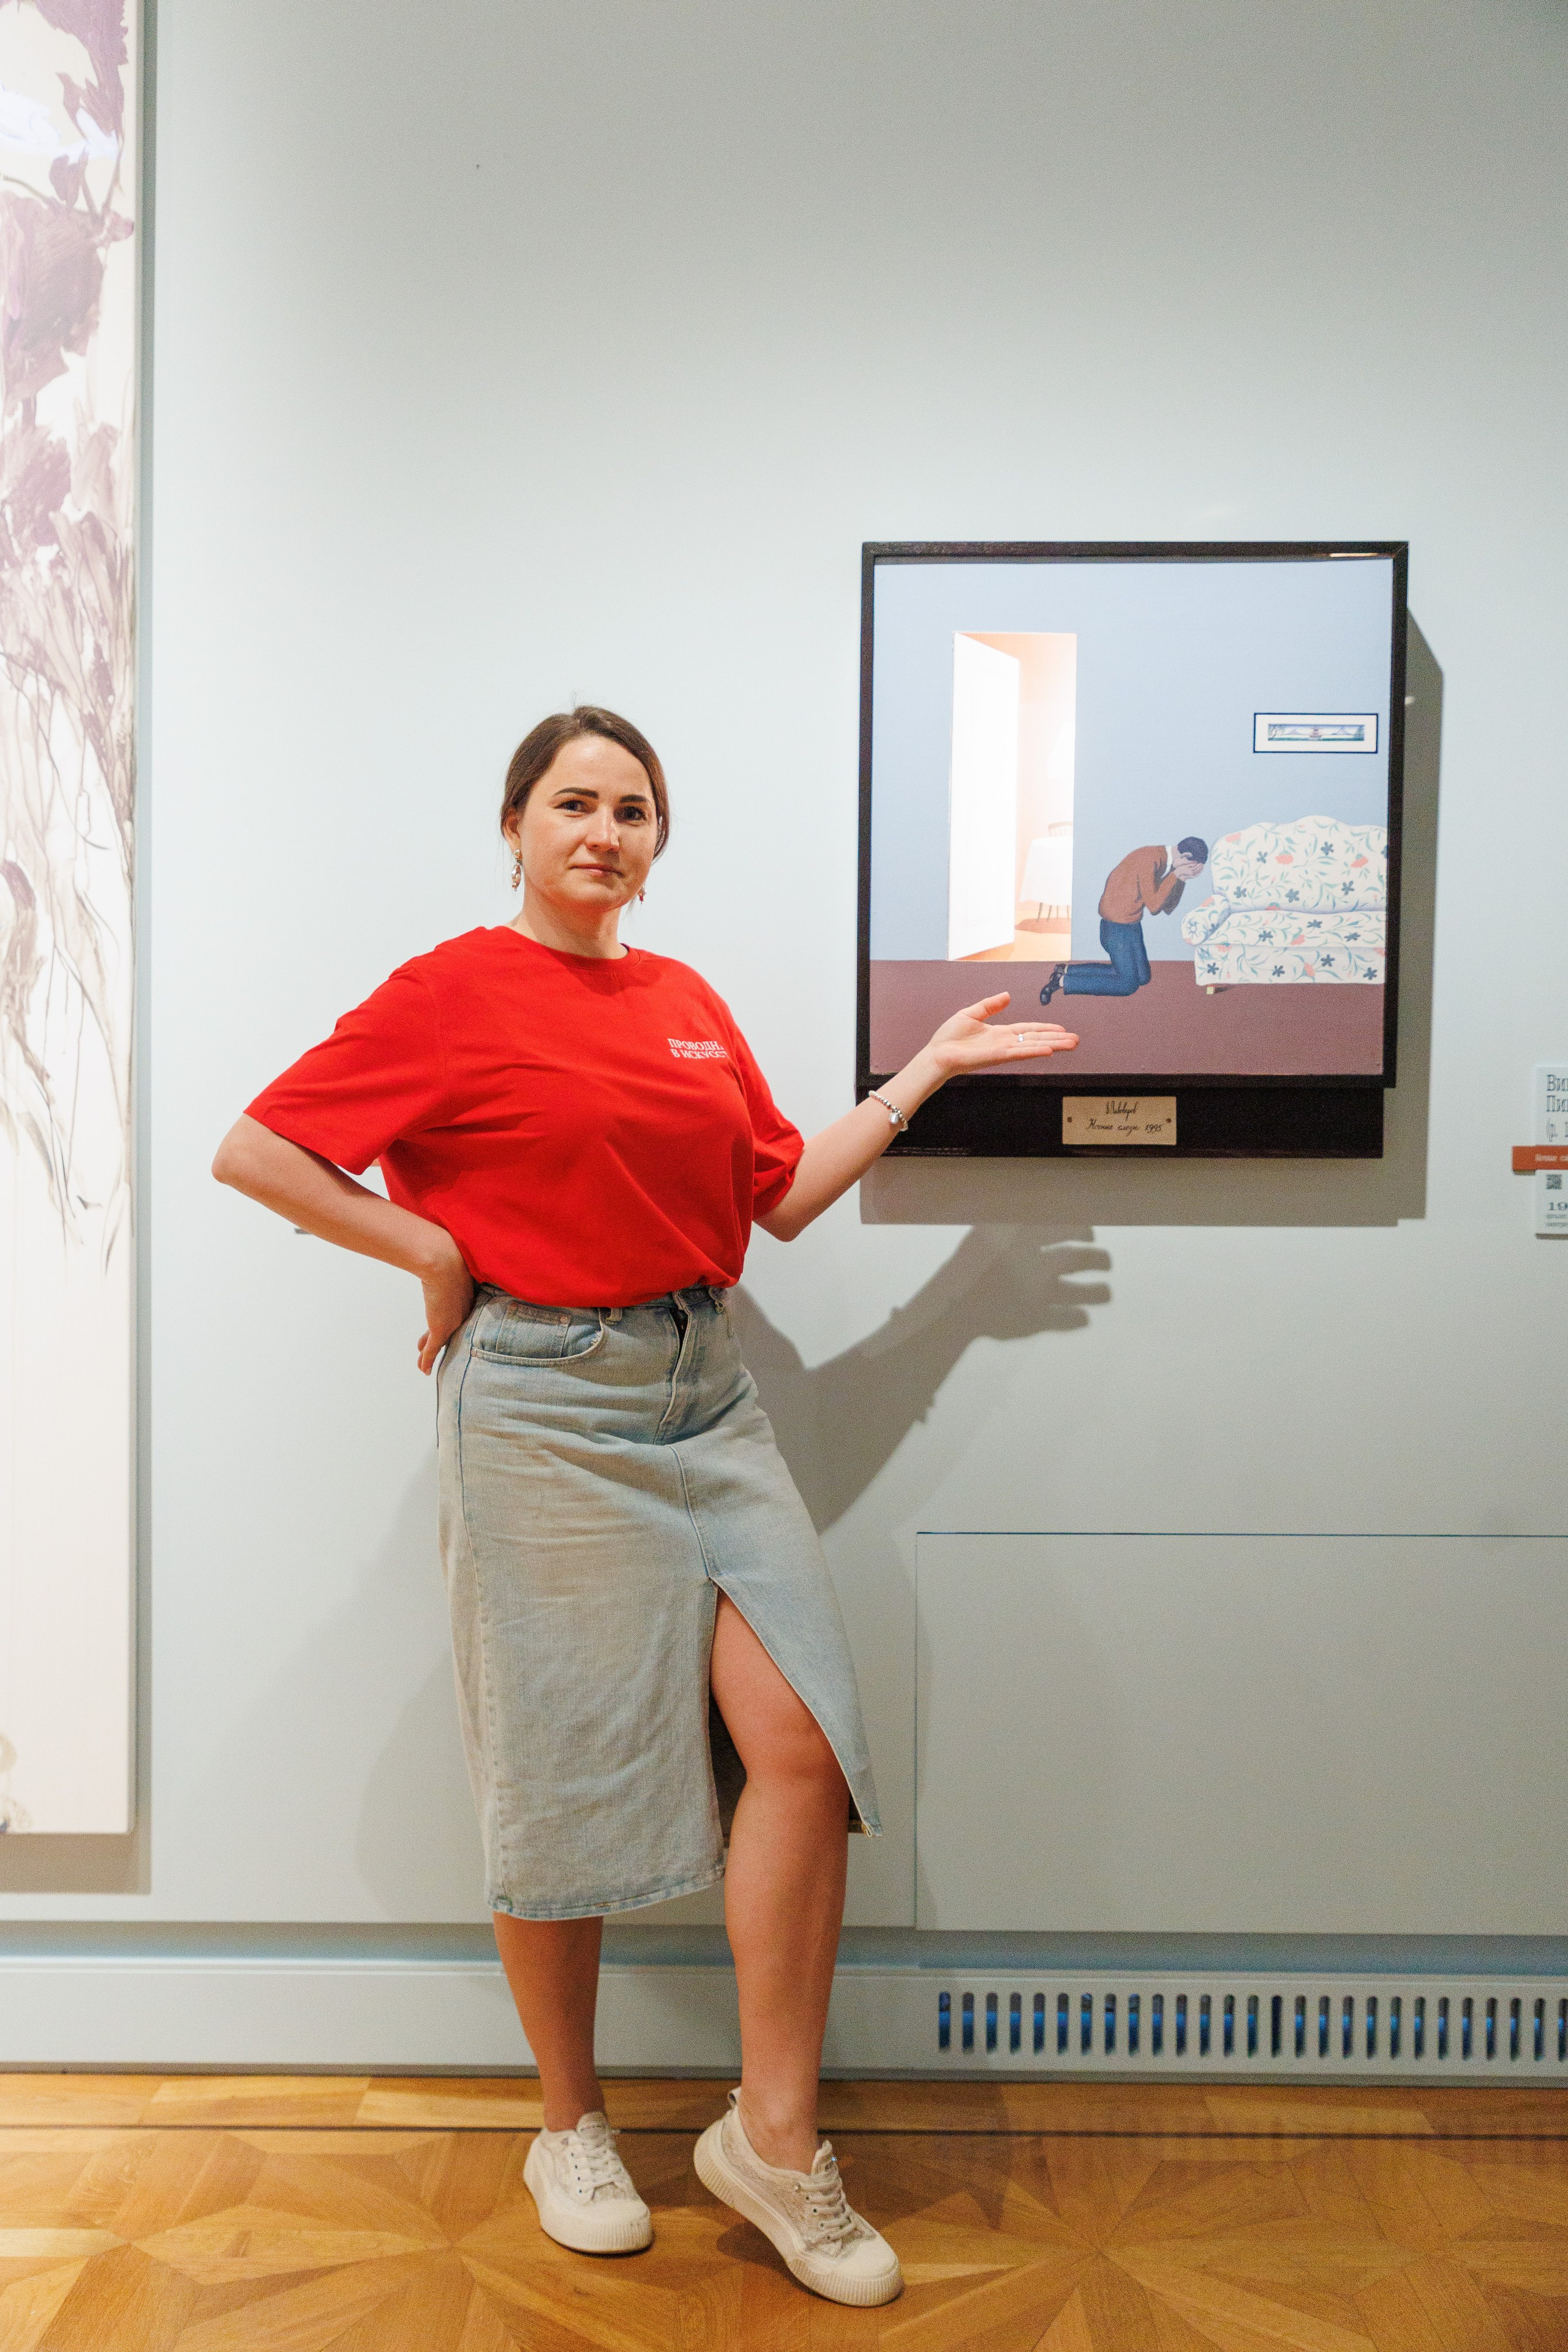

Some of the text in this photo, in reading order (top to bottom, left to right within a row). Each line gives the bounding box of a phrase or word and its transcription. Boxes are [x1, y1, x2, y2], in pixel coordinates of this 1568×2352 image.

[667, 1038, 724, 1050] ПРОВОДН
[670, 1049, 680, 1058] В
[1546, 1074, 1568, 1091] Ви
[1546, 1095, 1568, 1112] Пи
